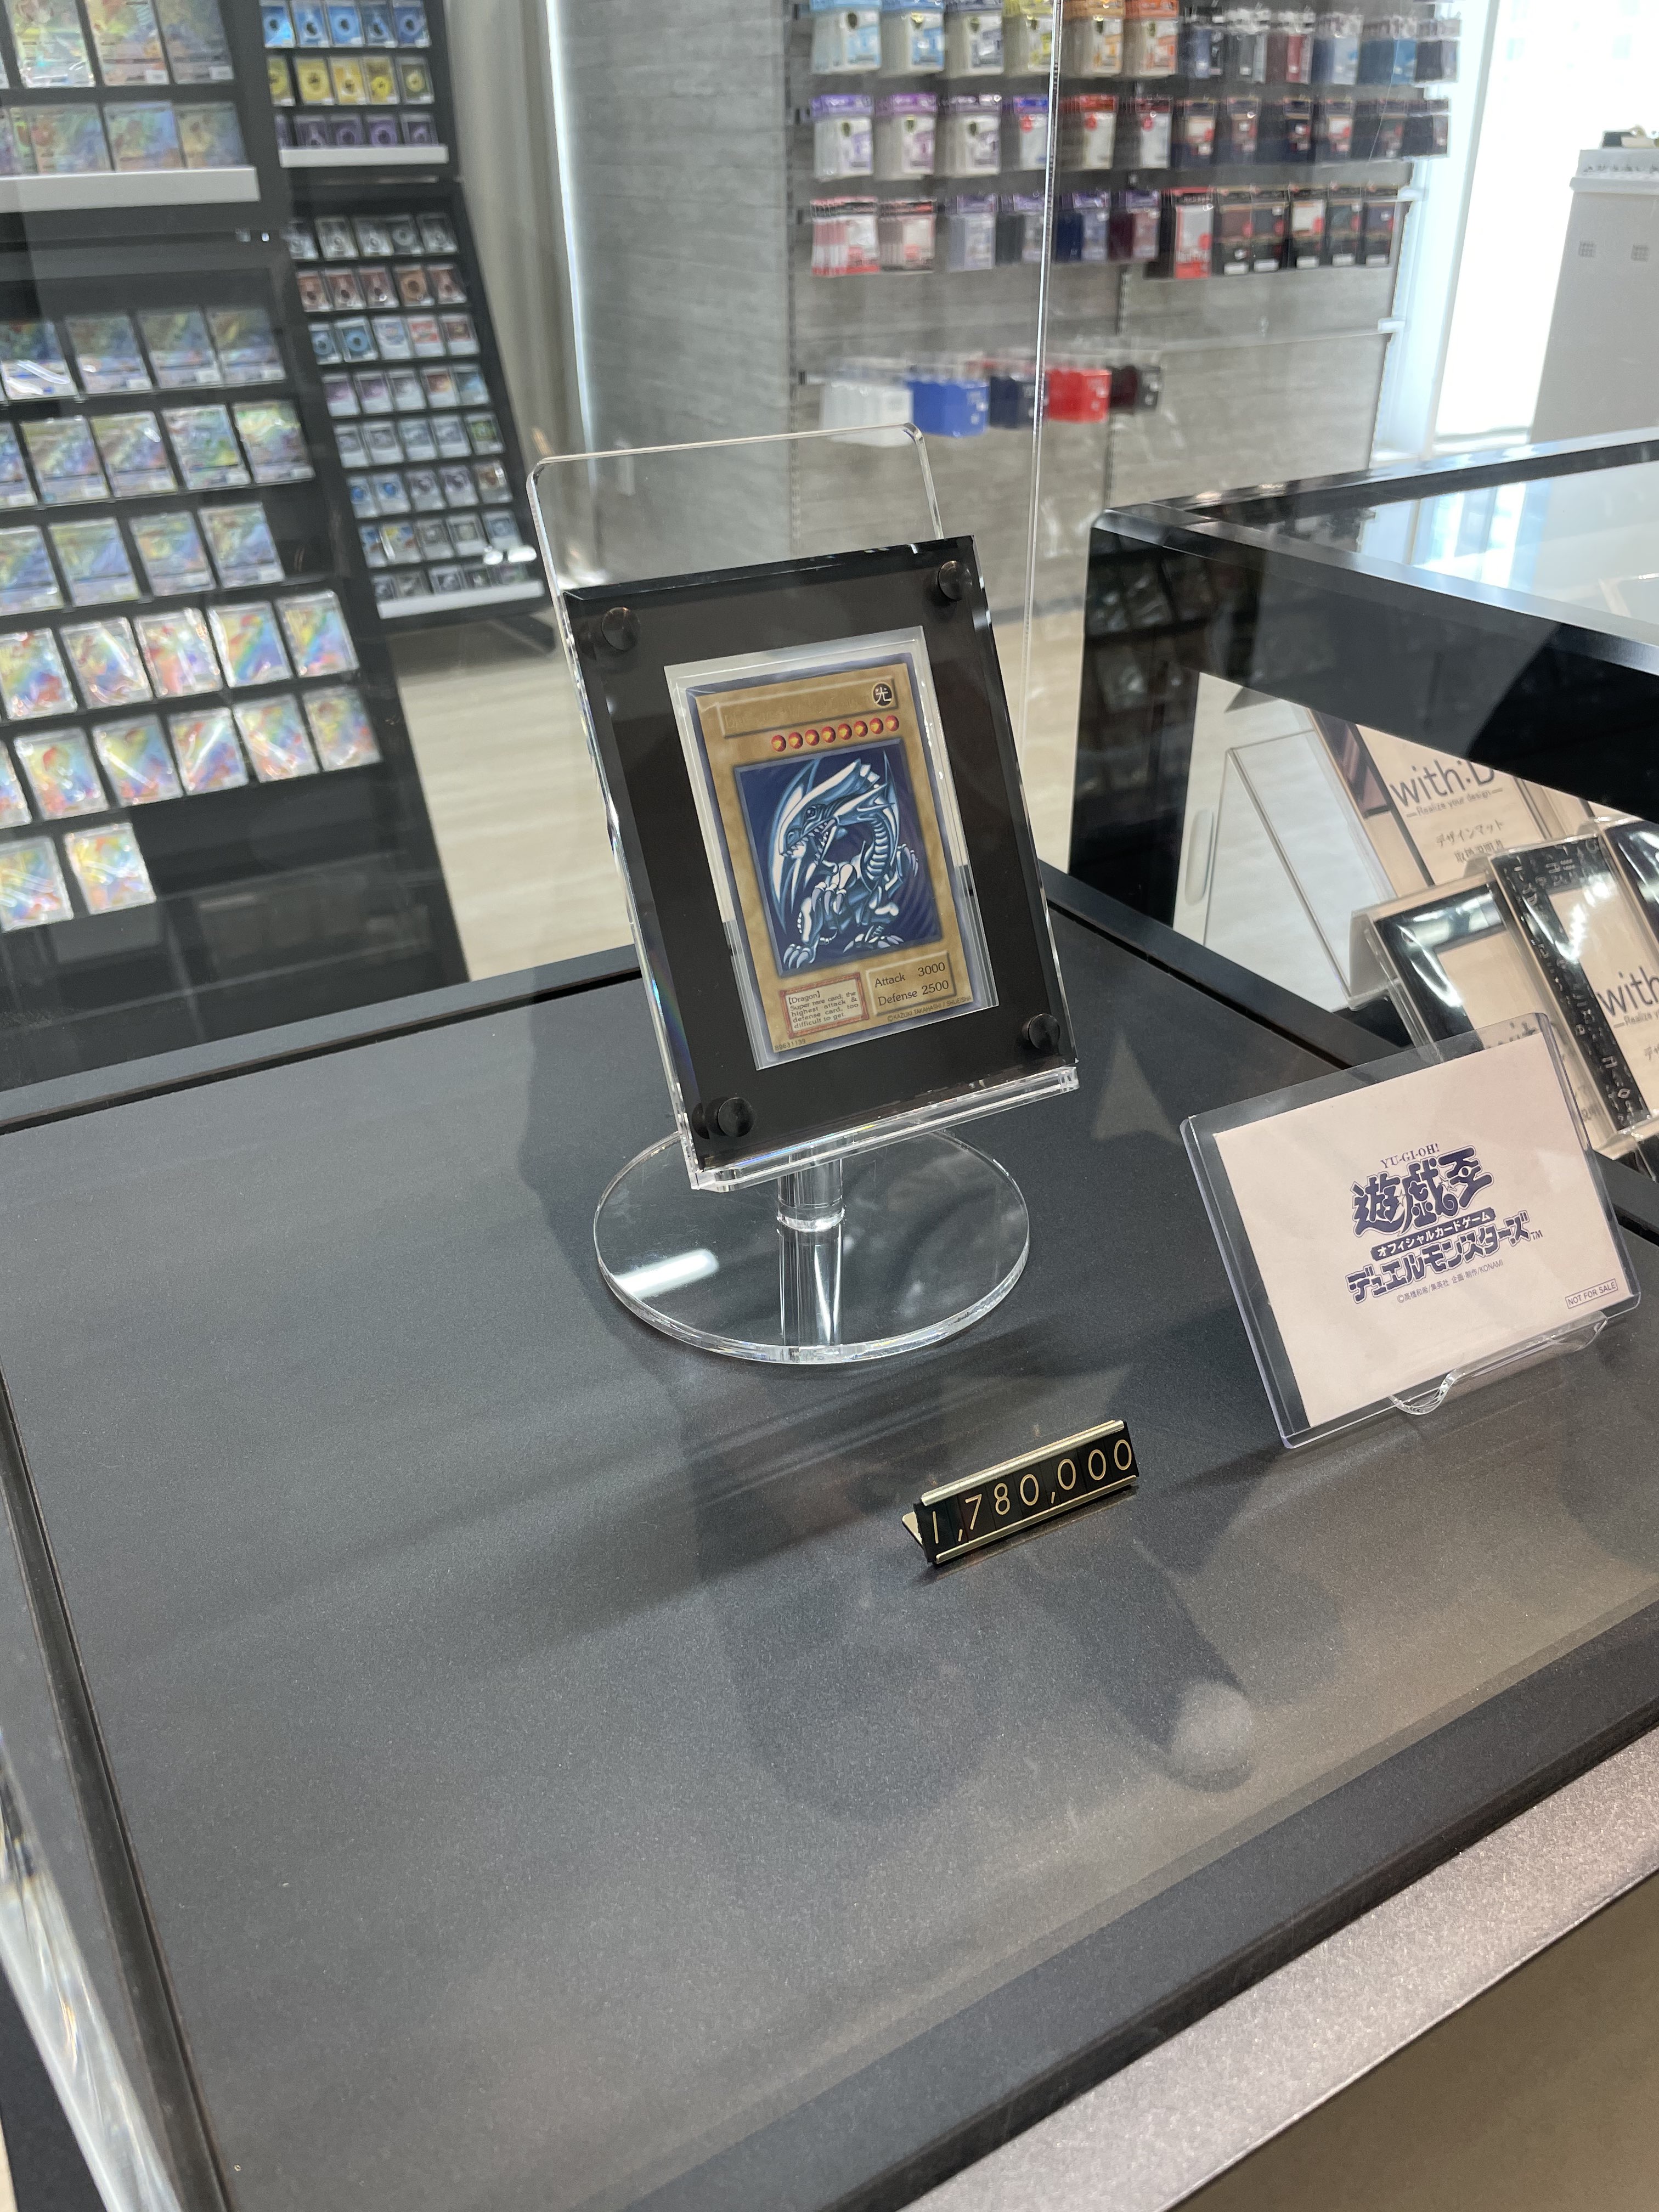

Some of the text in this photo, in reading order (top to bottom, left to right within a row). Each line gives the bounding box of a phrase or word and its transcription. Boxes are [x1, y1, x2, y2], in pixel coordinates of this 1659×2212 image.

[874, 686, 892, 704] 光
[1448, 797, 1465, 808] your
[1467, 789, 1491, 802] design
[874, 962, 945, 988] Attack 3000
[878, 980, 949, 1006] Defense 2500
[790, 1003, 810, 1011] Super
[791, 1007, 819, 1018] highest
[823, 1000, 846, 1009] attack
[913, 1003, 942, 1014] TAKAHASHI
[793, 1013, 821, 1023] defense
[794, 1018, 822, 1029] difficult
[1380, 1143, 1440, 1169] YU-GI-OH!
[1351, 1146, 1494, 1237] 遊戯王
[1376, 1211, 1491, 1257] オフィシャルカードゲーム
[1567, 1282, 1616, 1306] NOT FOR SALE
[932, 1439, 1132, 1544] 1,780,000
